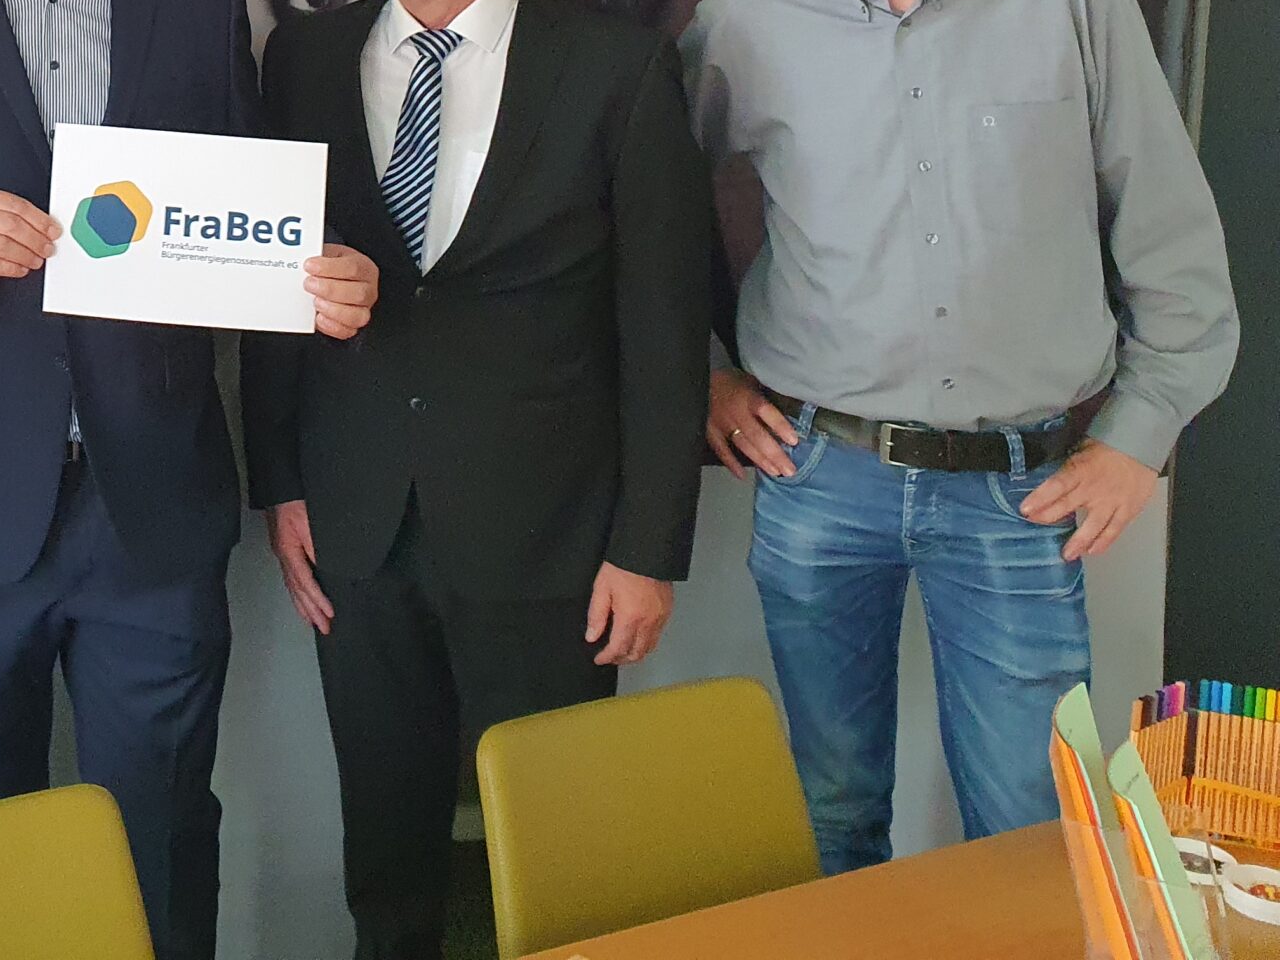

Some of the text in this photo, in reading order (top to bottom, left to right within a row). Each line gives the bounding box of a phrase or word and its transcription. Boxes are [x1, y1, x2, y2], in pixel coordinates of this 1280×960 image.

[163, 206, 302, 246] FraBeG
[161, 241, 209, 252] Frankfurter
[286, 261, 299, 269] eG
